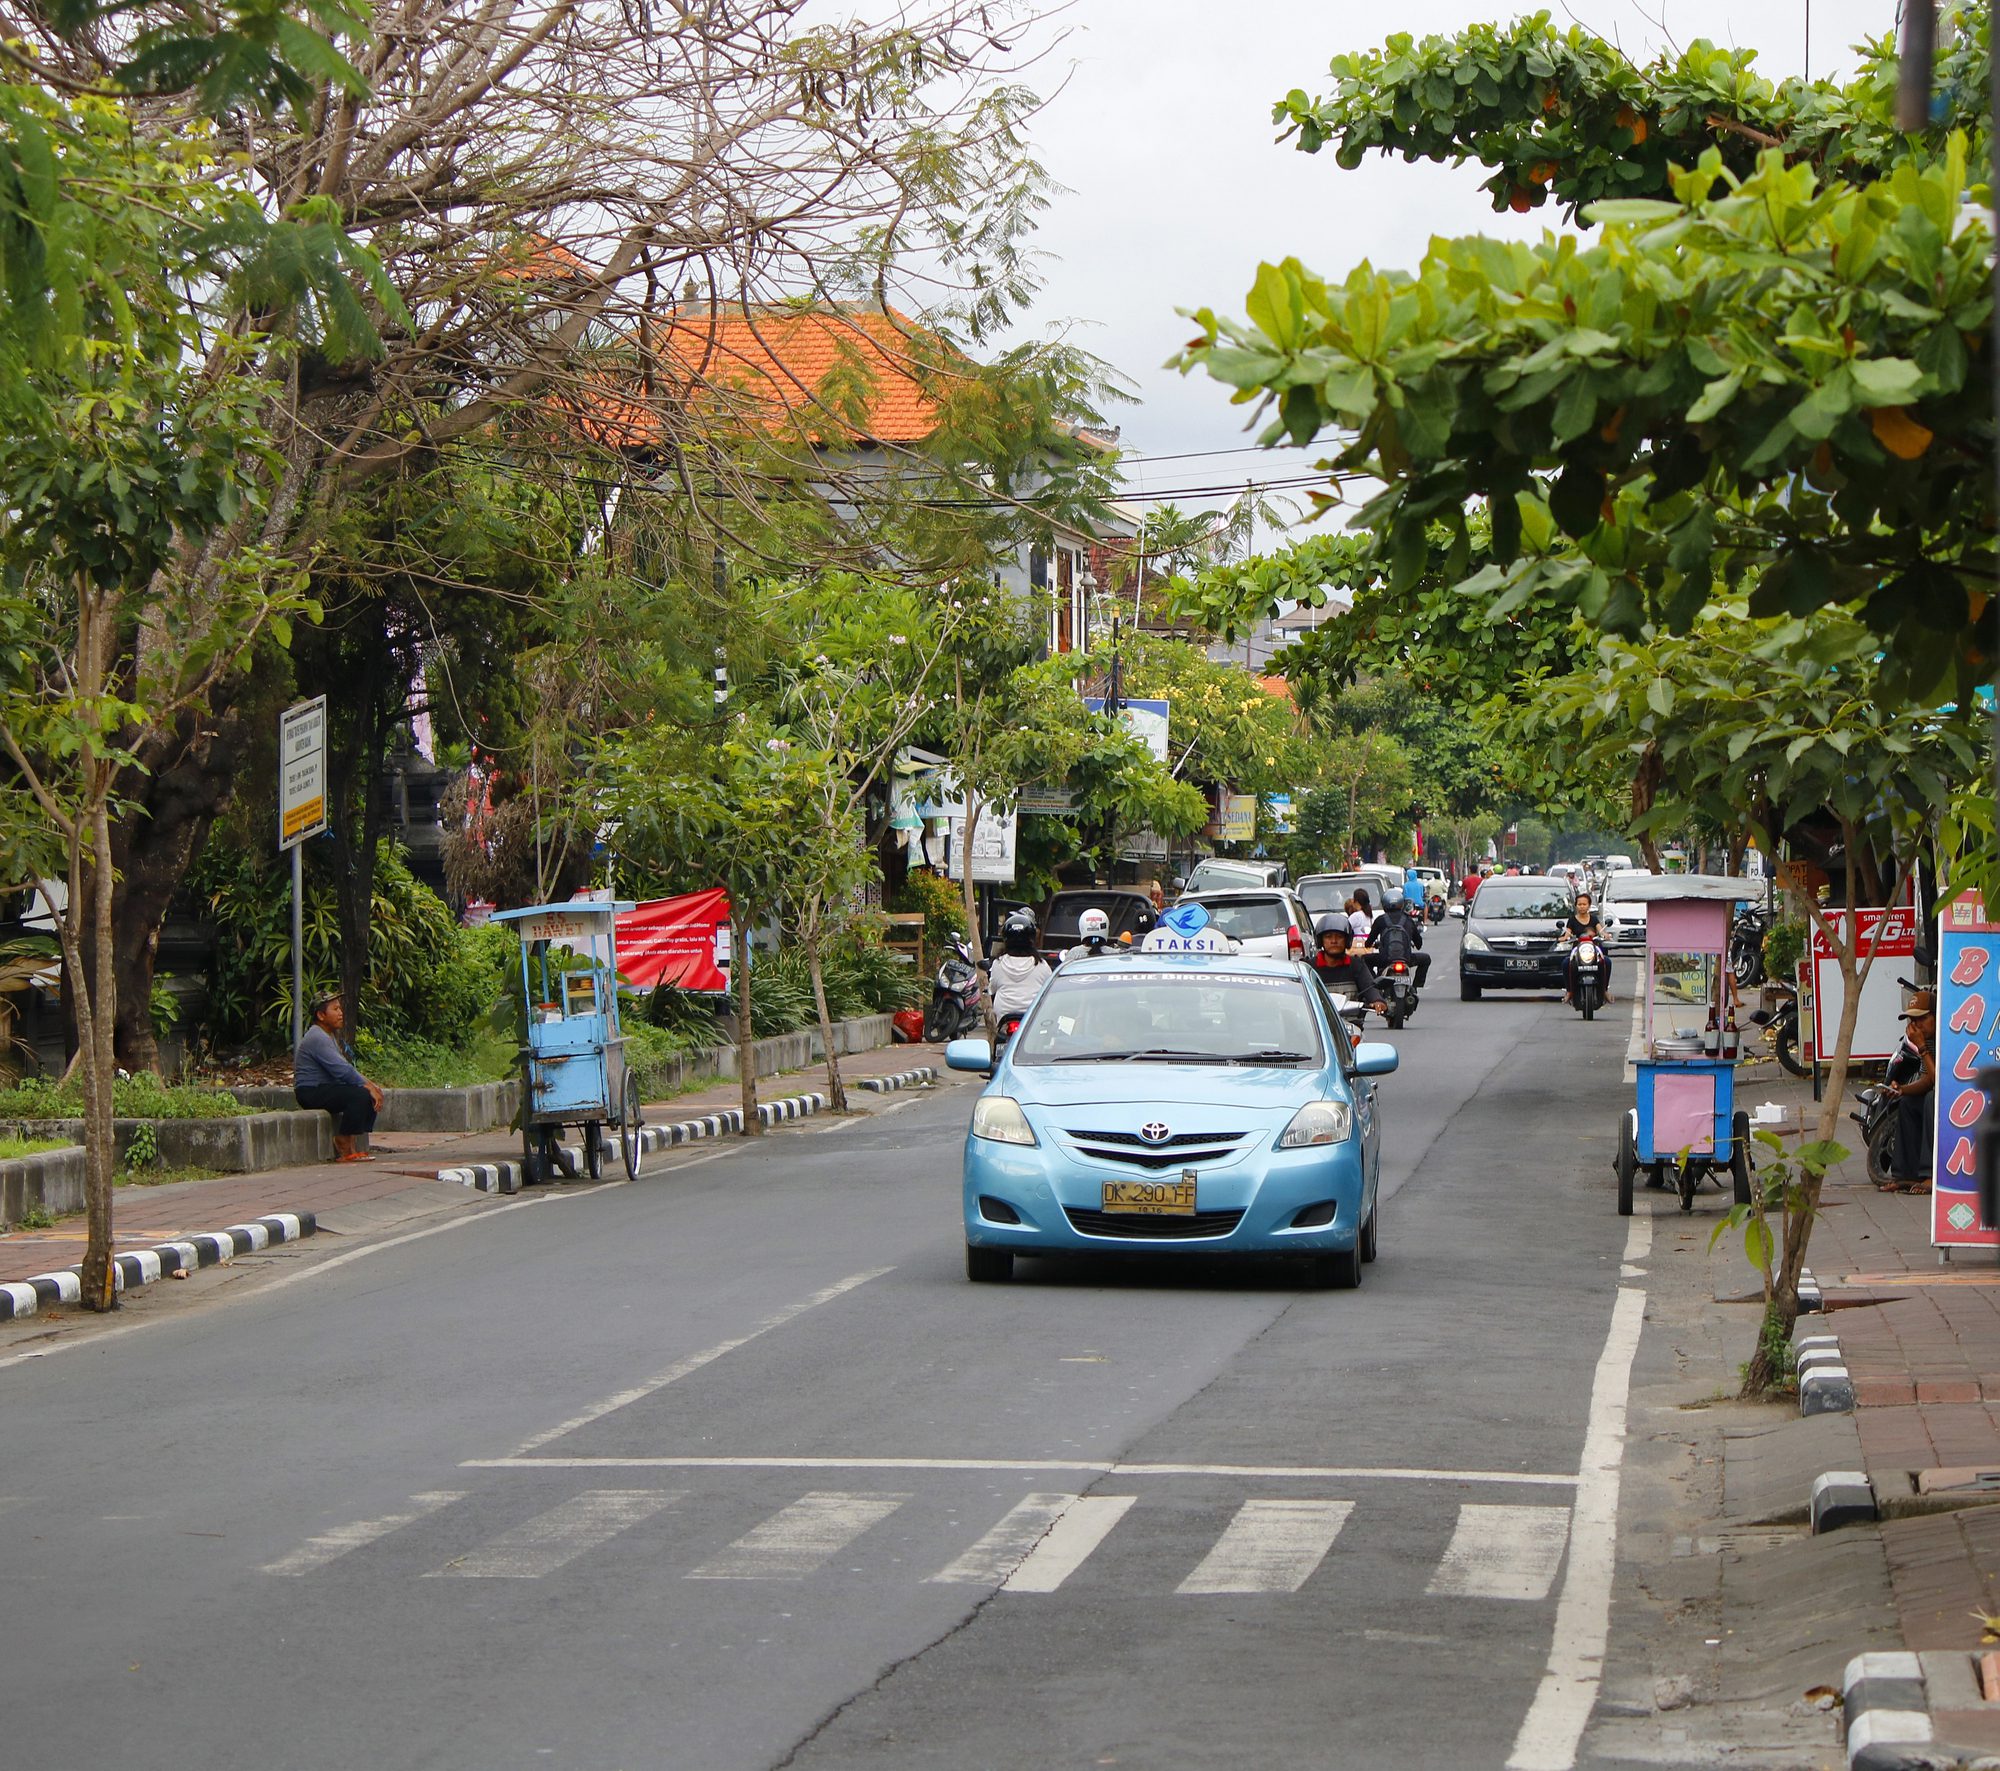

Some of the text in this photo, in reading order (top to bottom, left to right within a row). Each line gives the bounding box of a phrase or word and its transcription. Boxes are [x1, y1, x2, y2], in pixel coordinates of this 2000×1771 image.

[1863, 913, 1905, 922] smafren
[531, 922, 584, 938] DAWET
[1155, 938, 1214, 951] TAKSI
[1107, 973, 1286, 987] BLUE BIRD GROUP
[1681, 971, 1706, 981] MOT
[1945, 946, 1990, 1176] BALON
[1104, 1182, 1124, 1202] DK
[1133, 1182, 1165, 1203] 290
